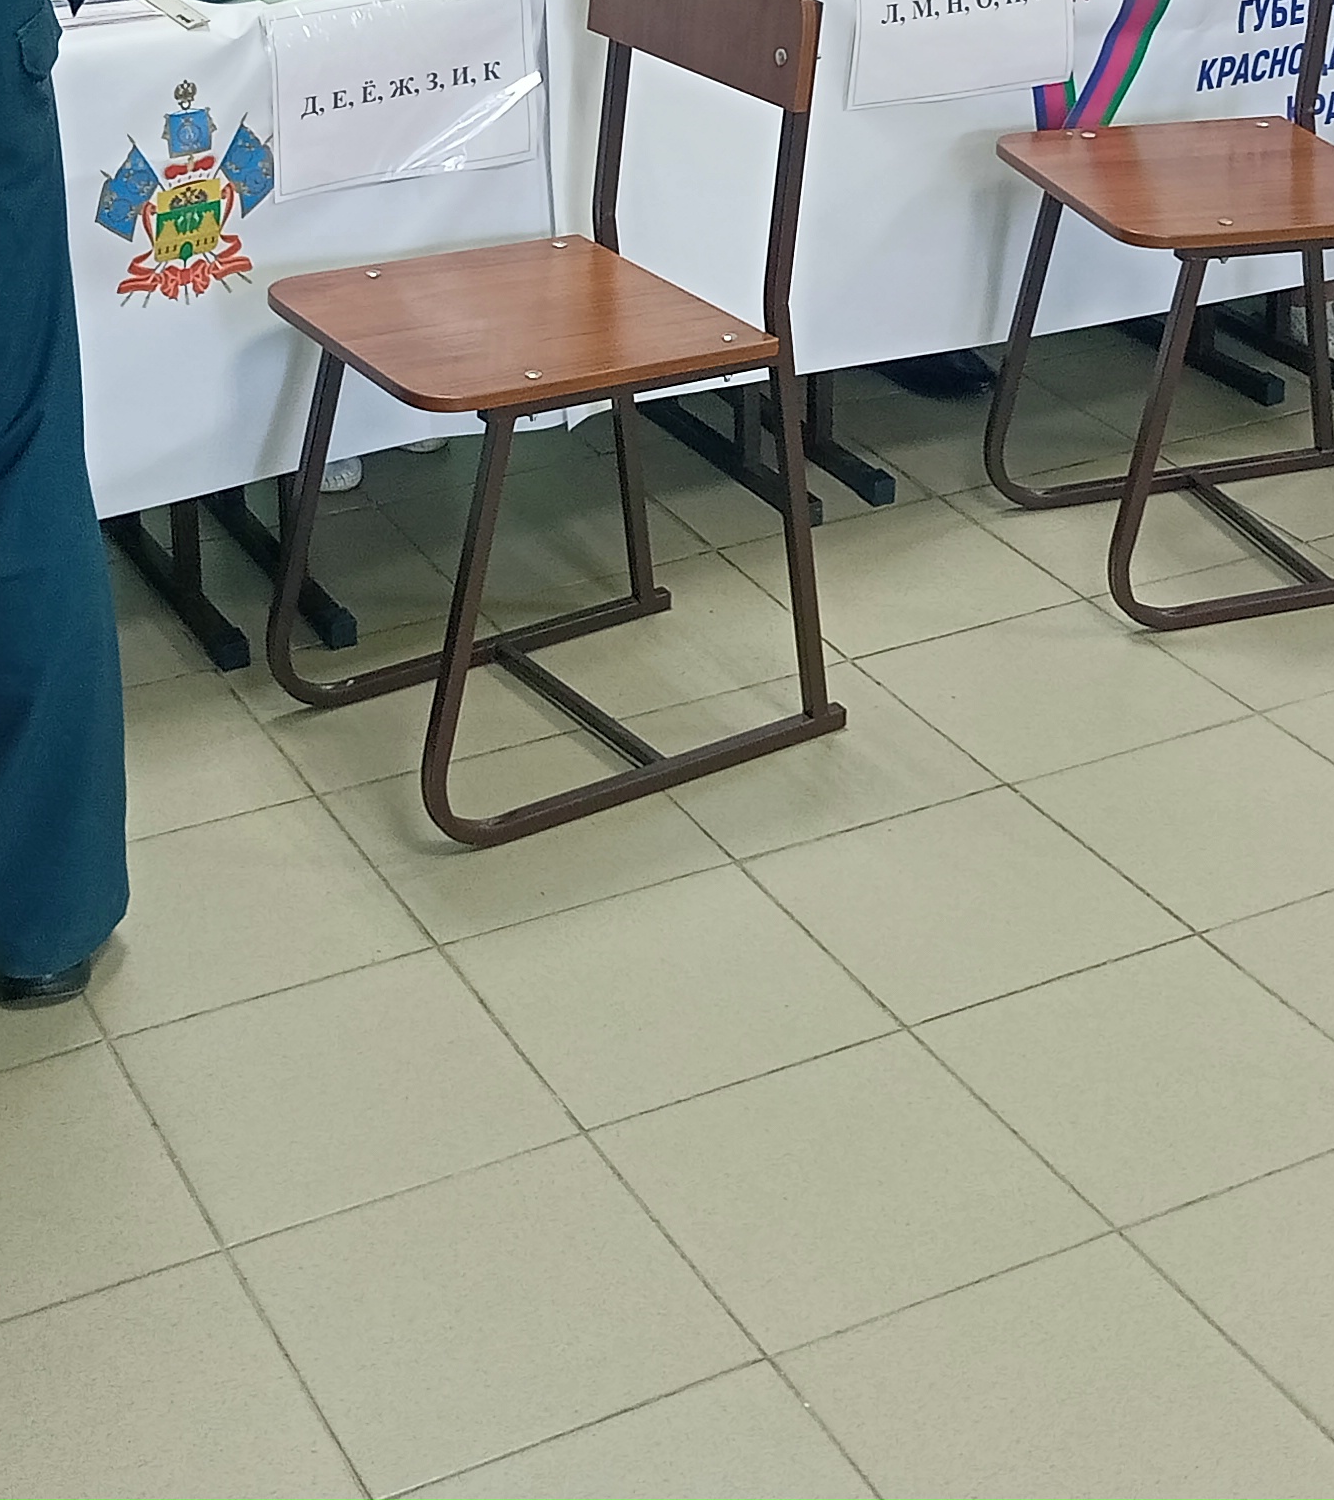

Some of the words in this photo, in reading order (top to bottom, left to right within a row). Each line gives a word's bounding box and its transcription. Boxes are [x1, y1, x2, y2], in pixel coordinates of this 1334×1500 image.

[881, 3, 906, 26] Л,
[301, 95, 325, 120] Д,
[332, 90, 354, 110] Е,
[361, 80, 384, 104] Ё,
[389, 76, 420, 99] Ж,
[426, 72, 445, 92] З,
[452, 66, 477, 87] И,
[483, 61, 501, 81] К
